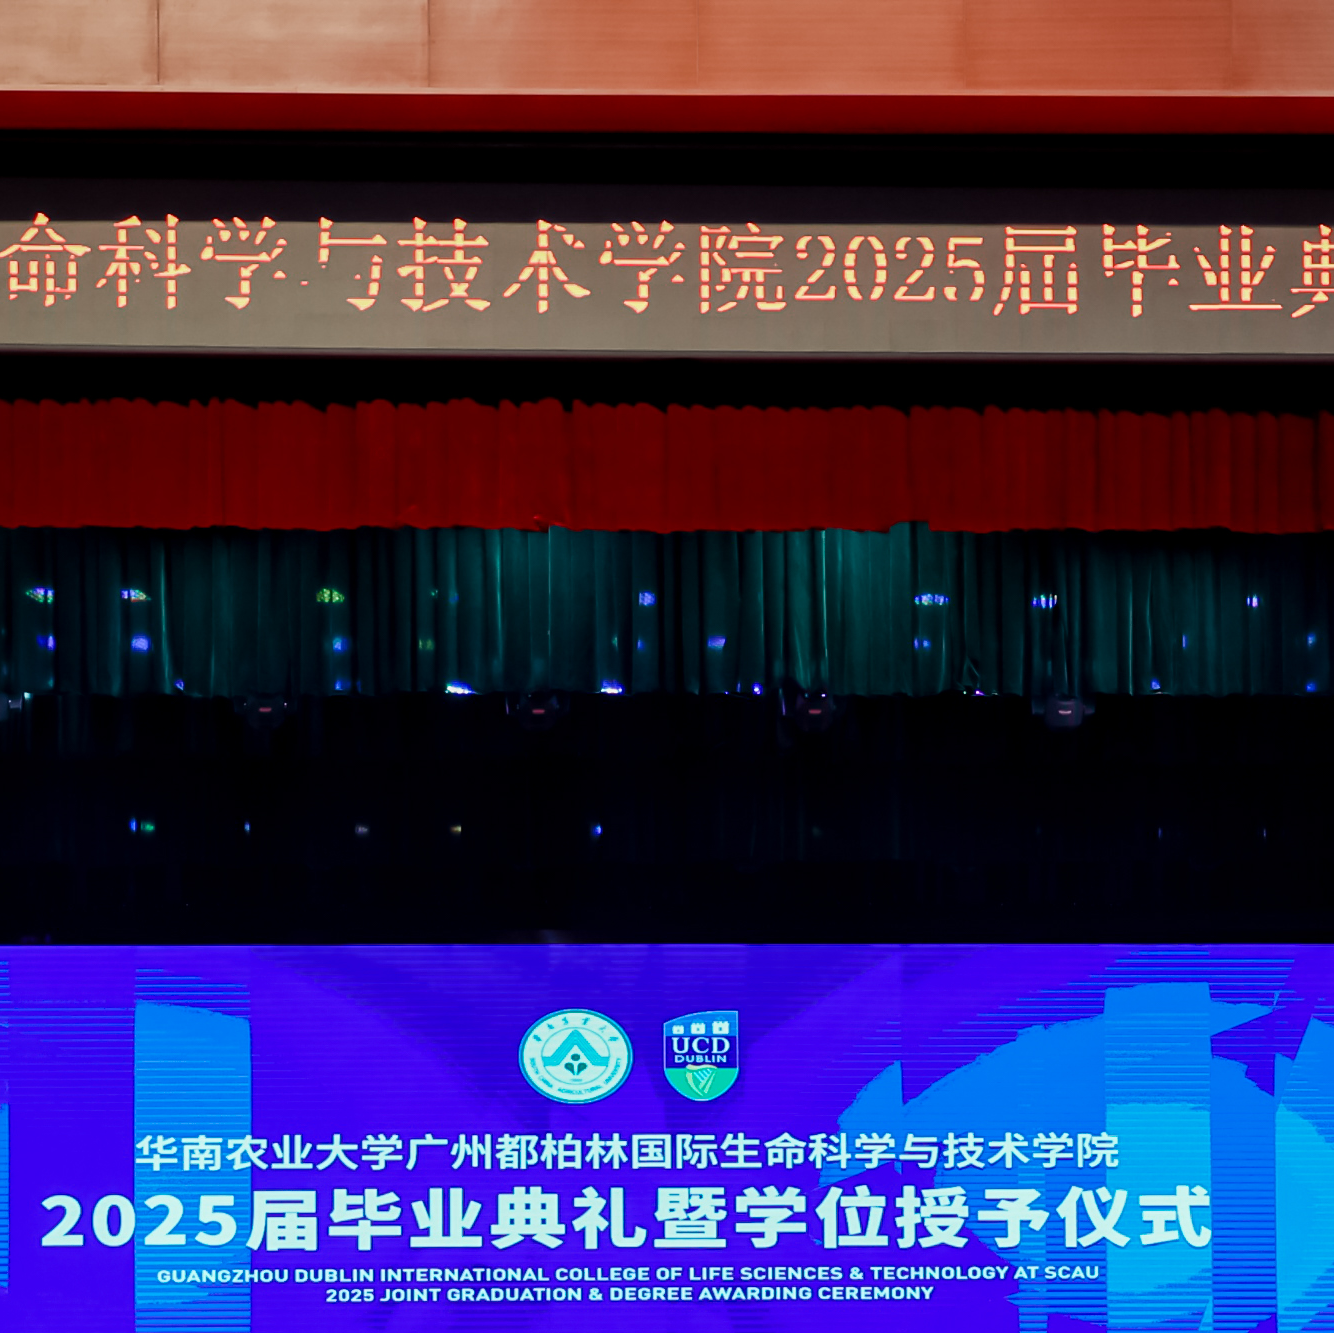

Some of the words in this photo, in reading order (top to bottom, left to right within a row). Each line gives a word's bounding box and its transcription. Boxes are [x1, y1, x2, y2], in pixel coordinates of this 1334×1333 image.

[671, 1036, 731, 1054] UCD
[674, 1054, 727, 1063] DUBLIN
[135, 1132, 1119, 1171] 华南农业大学广州都柏林国际生命科学与技术学院
[40, 1184, 1213, 1251] 2025届毕业典礼暨学位授予仪式
[157, 1269, 288, 1283] GUANGZHOU
[295, 1268, 374, 1282] DUBLIN
[380, 1267, 550, 1282] INTERNATIONAL
[555, 1267, 650, 1281] COLLEGE
[656, 1267, 683, 1281] OF
[689, 1267, 734, 1281] LIFE
[740, 1266, 843, 1280] SCIENCES
[849, 1267, 864, 1280] &
[869, 1266, 1009, 1280] TECHNOLOGY
[1013, 1266, 1039, 1279] AT
[1044, 1266, 1099, 1279] SCAU
[326, 1288, 374, 1302] 2025
[379, 1288, 442, 1302] JOINT
[447, 1287, 582, 1302] GRADUATION
[588, 1288, 603, 1301] &
[610, 1287, 693, 1301] DEGREE
[698, 1286, 812, 1300] AWARDING
[818, 1286, 934, 1300] CEREMONY
